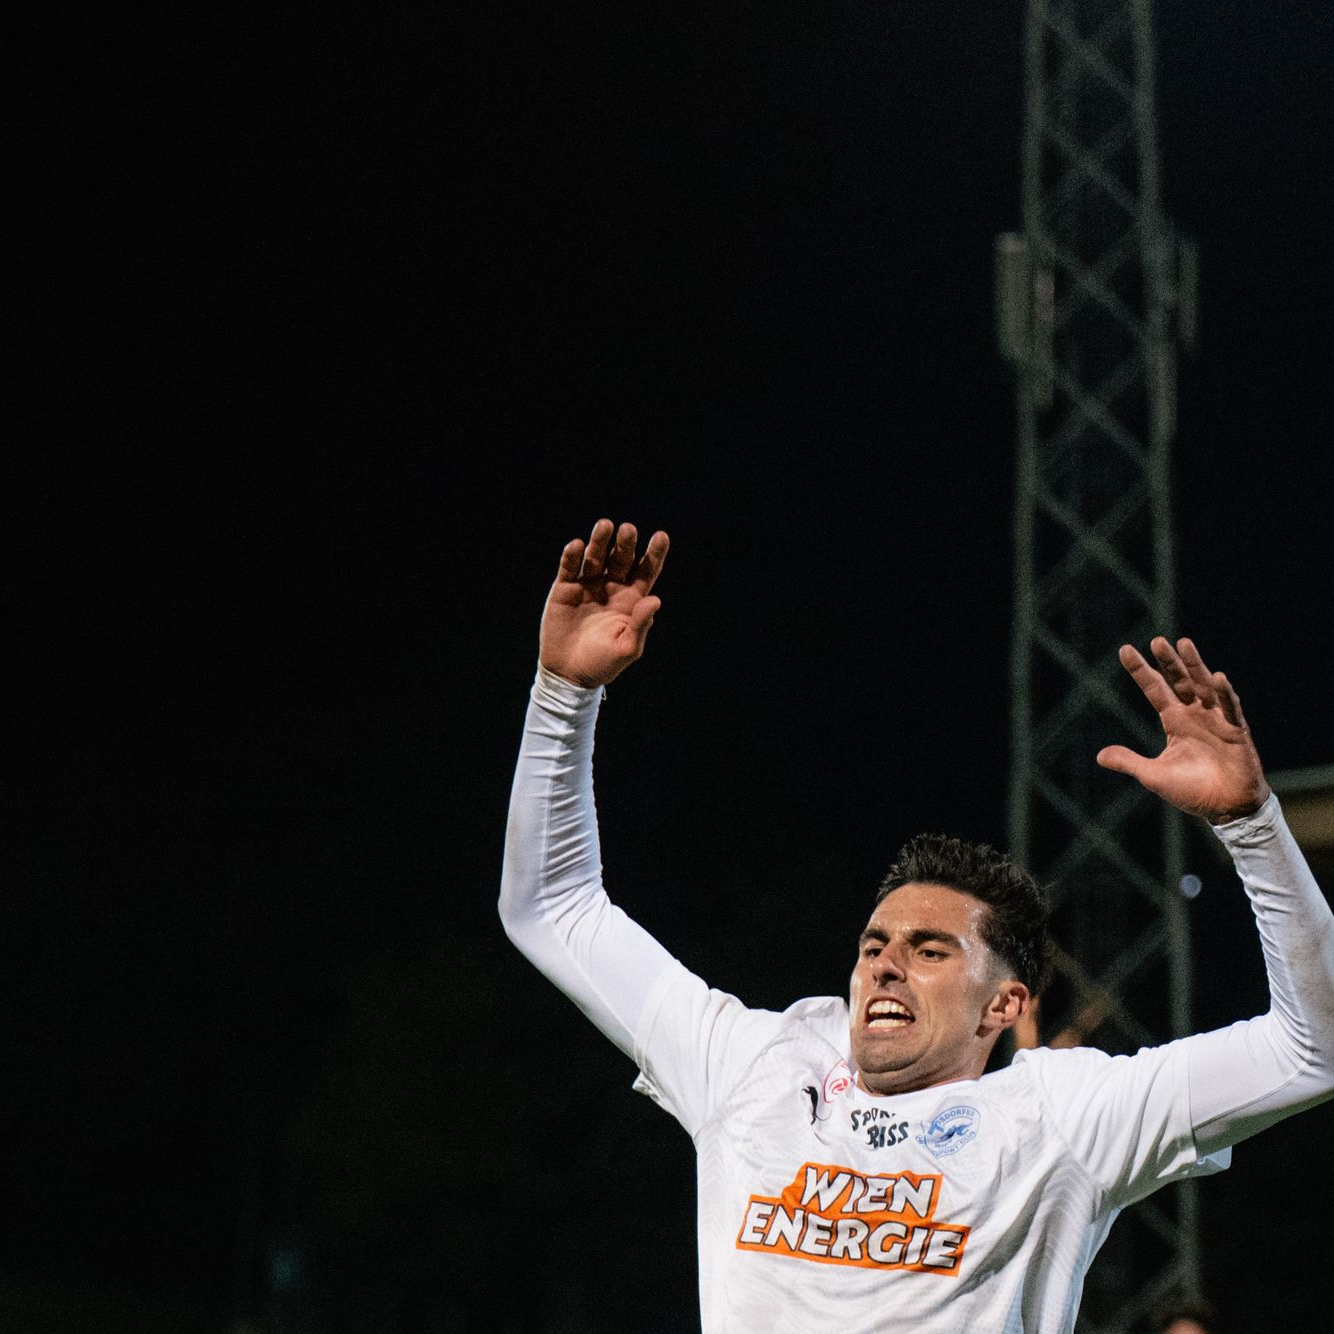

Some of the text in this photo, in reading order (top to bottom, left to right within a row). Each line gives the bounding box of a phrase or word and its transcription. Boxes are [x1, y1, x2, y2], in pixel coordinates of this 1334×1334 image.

[851, 1107, 896, 1131] SPOR
[800, 1165, 936, 1219] WIEN
[739, 1200, 965, 1268] ENERGIE
